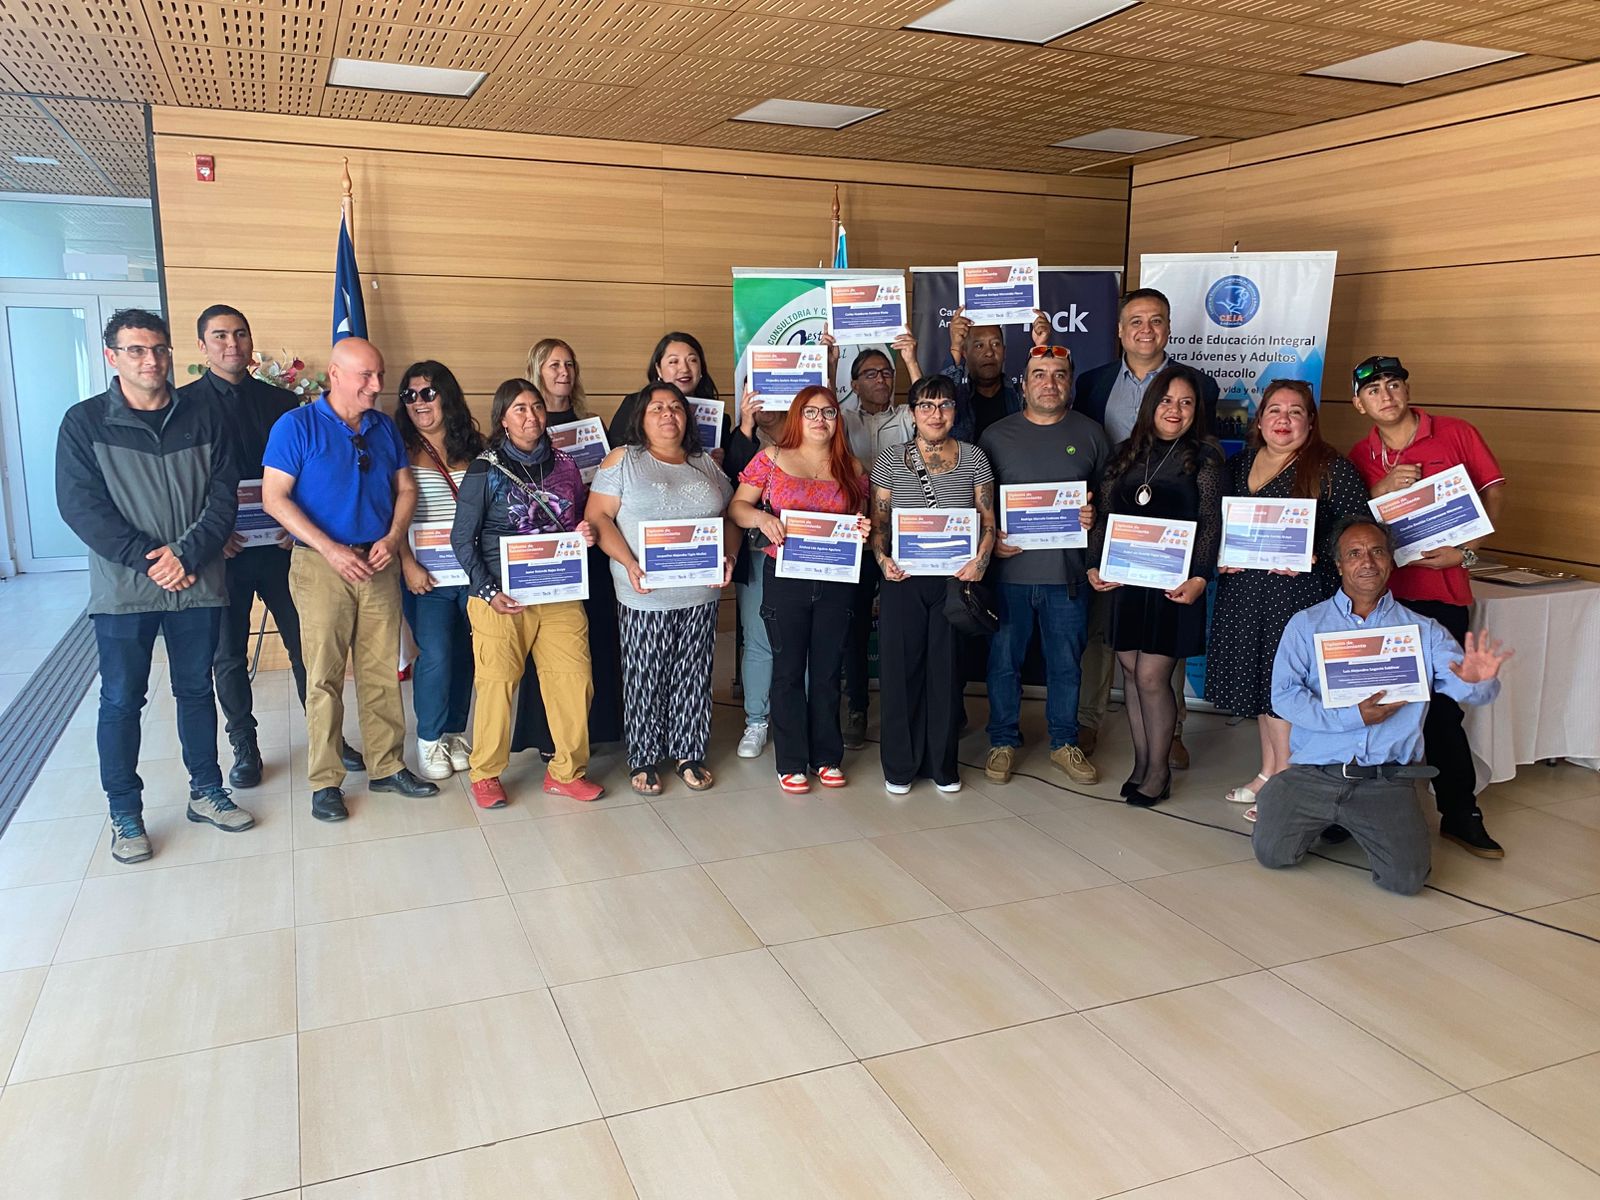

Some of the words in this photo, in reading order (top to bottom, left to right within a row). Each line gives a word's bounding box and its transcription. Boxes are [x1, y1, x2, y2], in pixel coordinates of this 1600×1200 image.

[767, 308, 811, 345] CONSULTORIA
[813, 307, 819, 315] Y
[1188, 334, 1203, 345] de
[1206, 334, 1265, 346] Educación
[1269, 335, 1315, 348] Integral
[1190, 350, 1237, 362] Jóvenes
[1240, 354, 1247, 363] y
[1250, 352, 1296, 362] Adultos
[1223, 386, 1241, 394] vida
[1244, 387, 1249, 395] y
[1251, 386, 1259, 394] el
